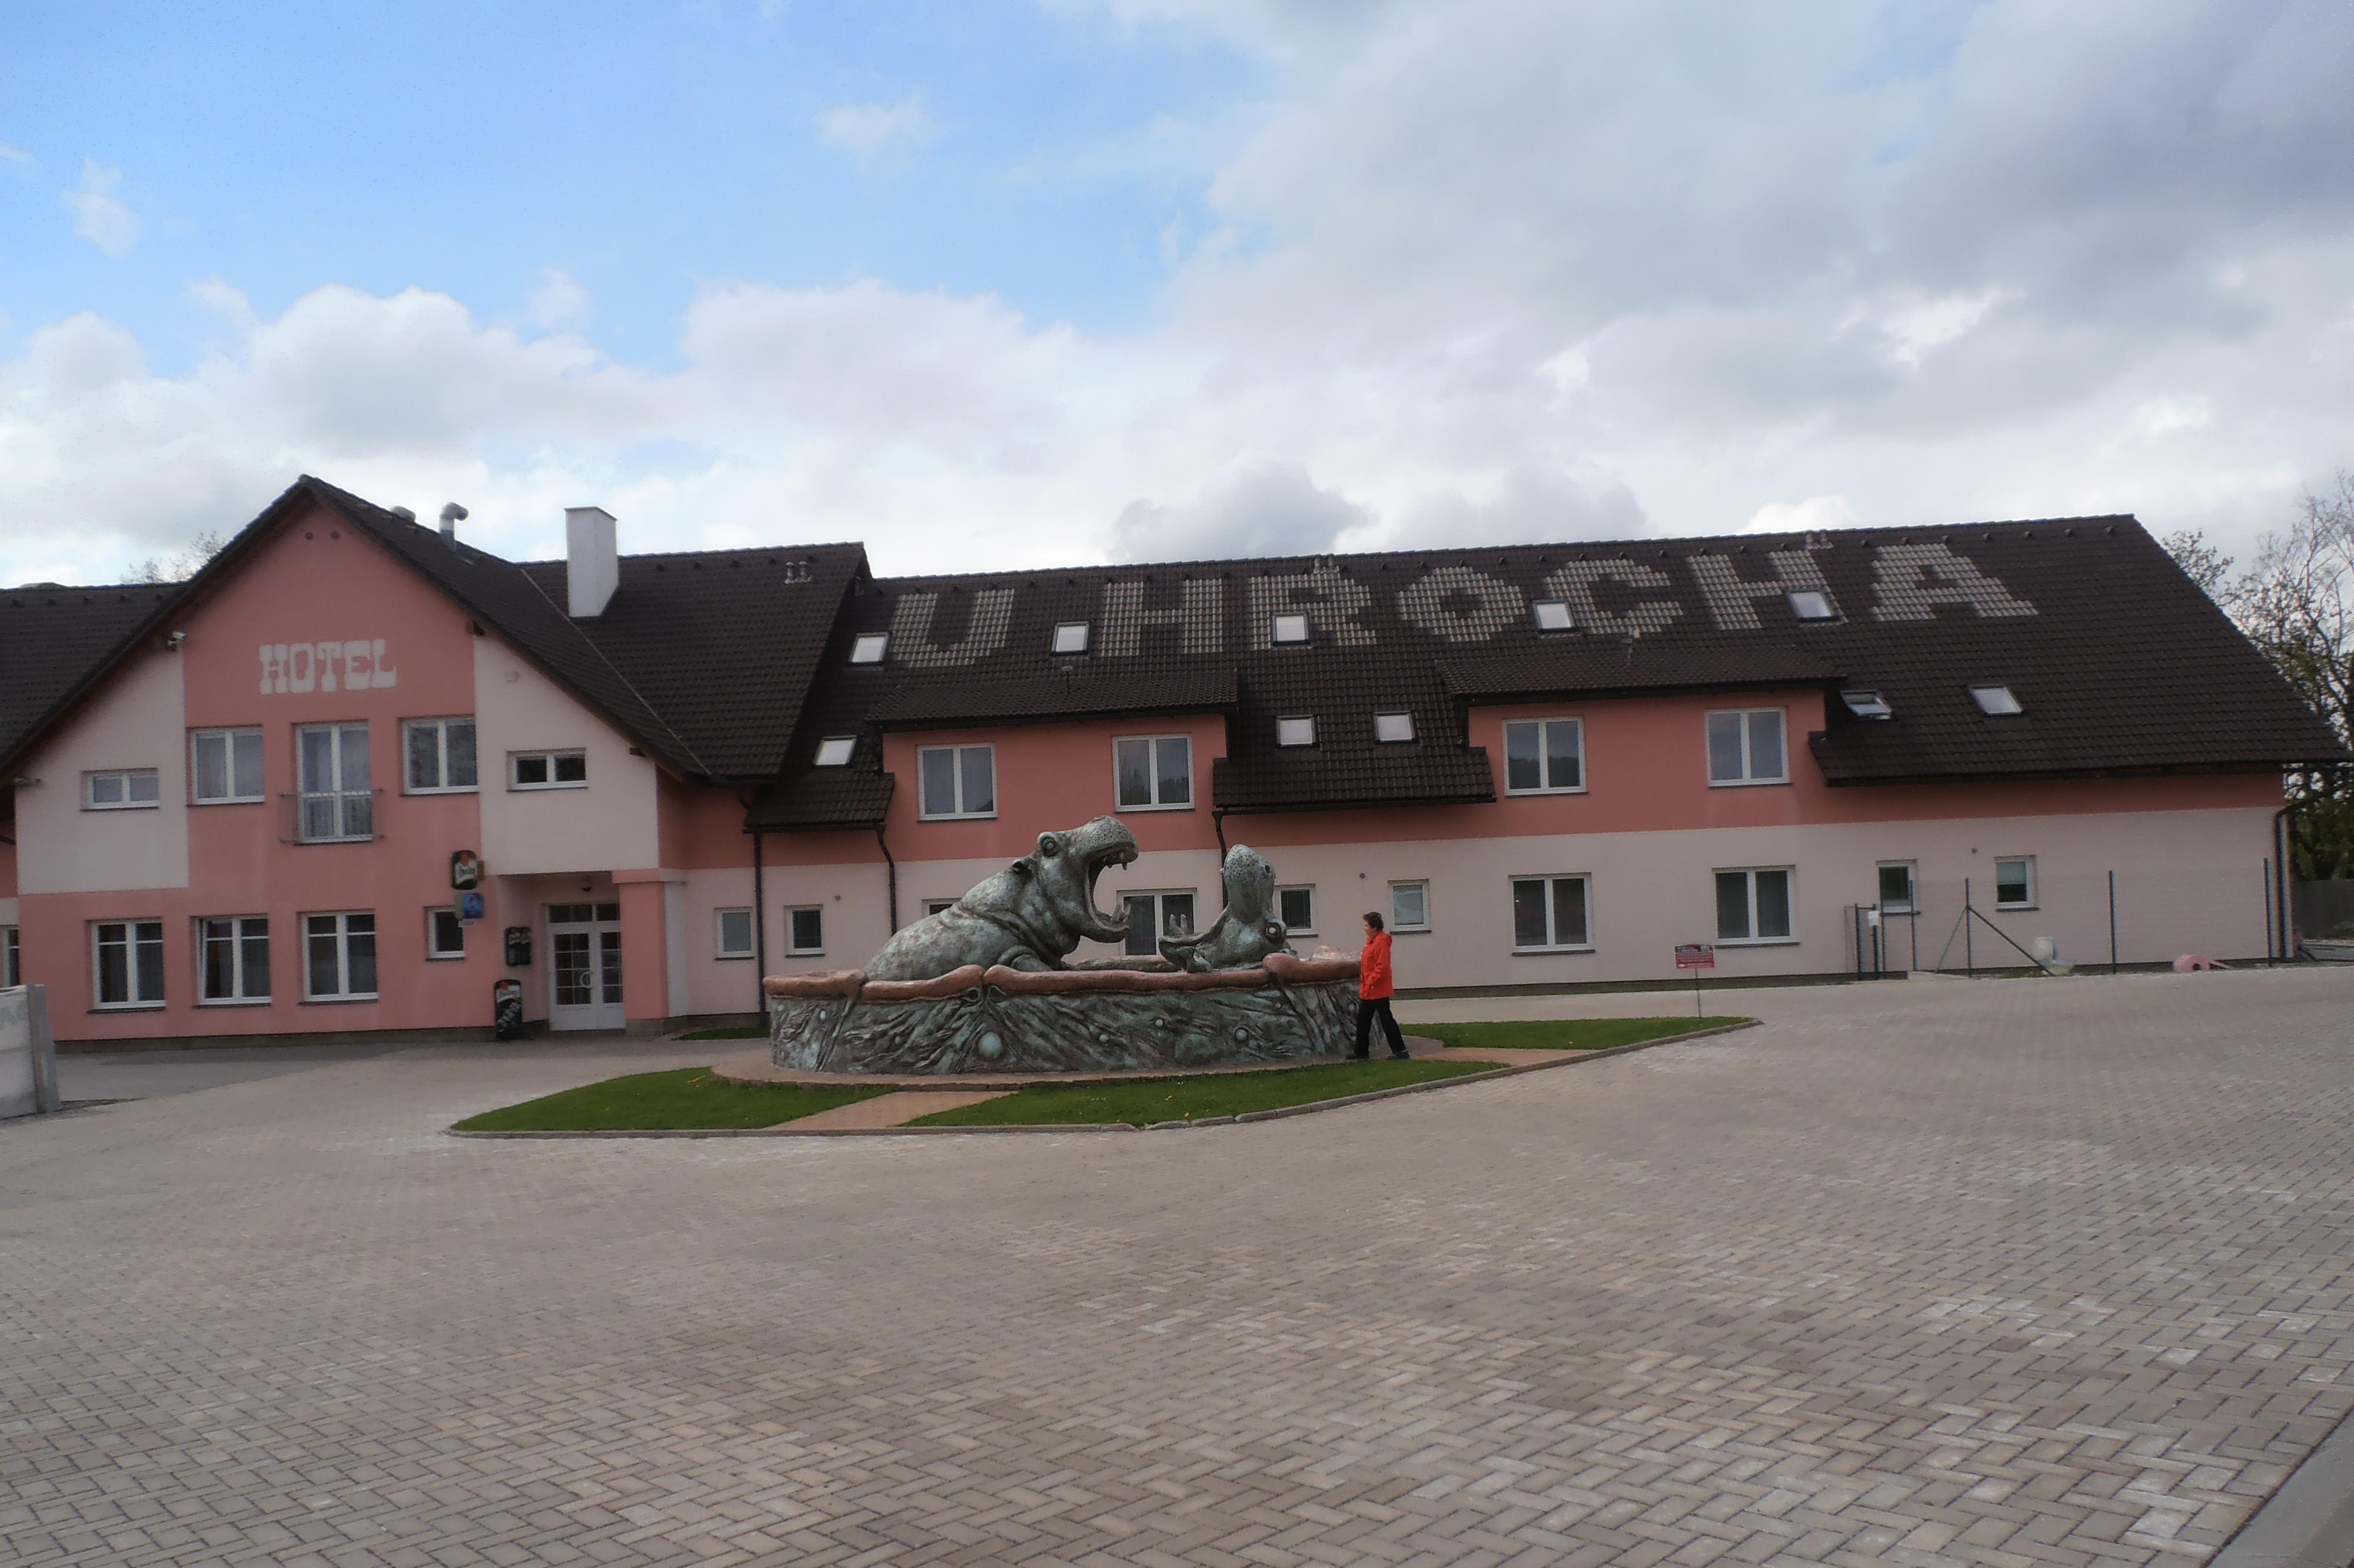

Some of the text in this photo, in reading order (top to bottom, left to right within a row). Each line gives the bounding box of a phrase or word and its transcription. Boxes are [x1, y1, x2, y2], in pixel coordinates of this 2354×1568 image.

[889, 543, 2039, 668] U HROCHA
[259, 639, 397, 695] HOTEL
